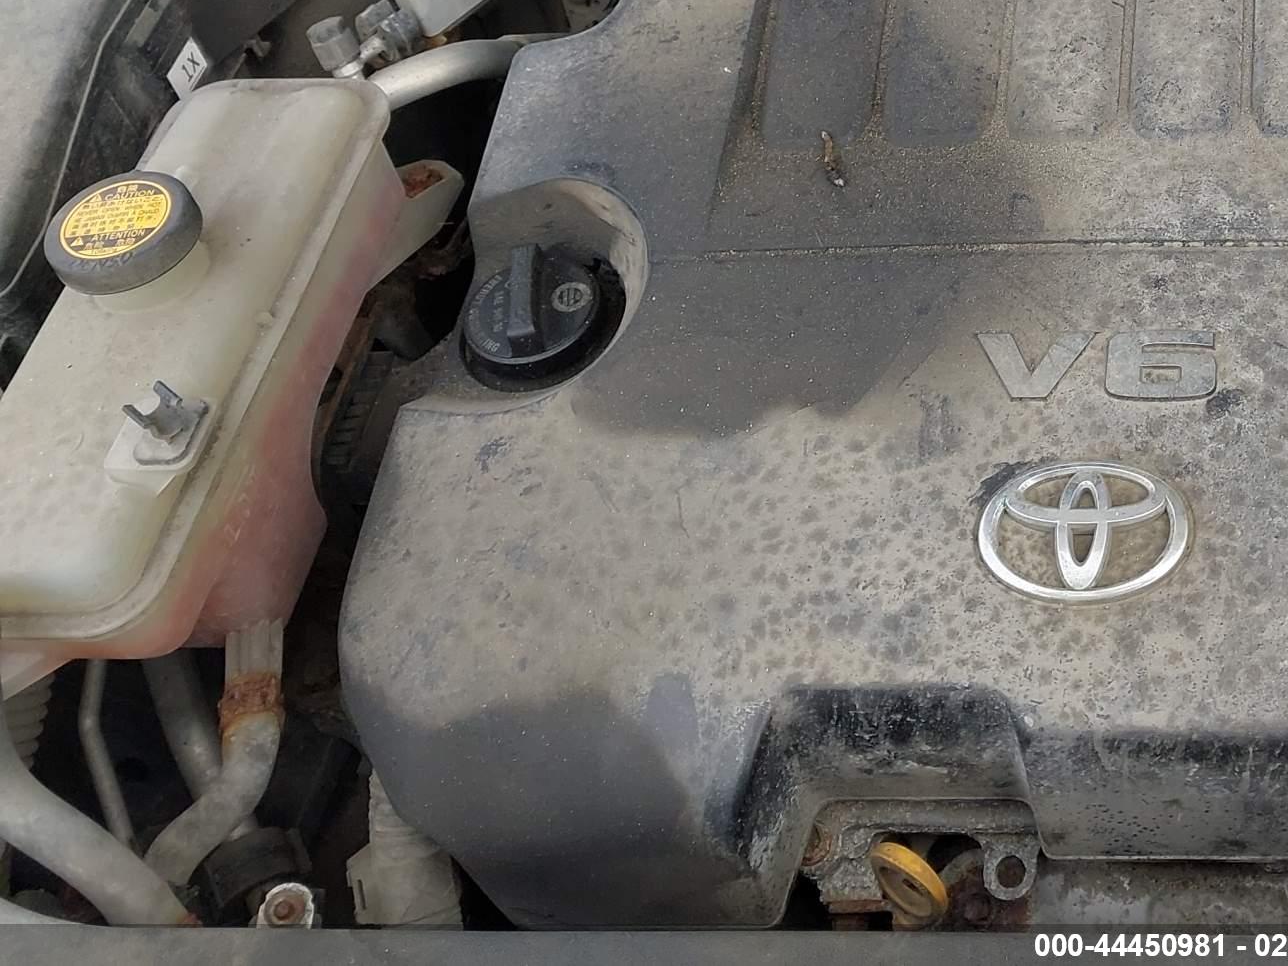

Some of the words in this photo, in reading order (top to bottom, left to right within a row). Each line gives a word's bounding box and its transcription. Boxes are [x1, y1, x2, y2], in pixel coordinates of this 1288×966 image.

[105, 189, 155, 201] CAUTION
[91, 229, 146, 241] ATTENTION
[976, 333, 1217, 402] V6
